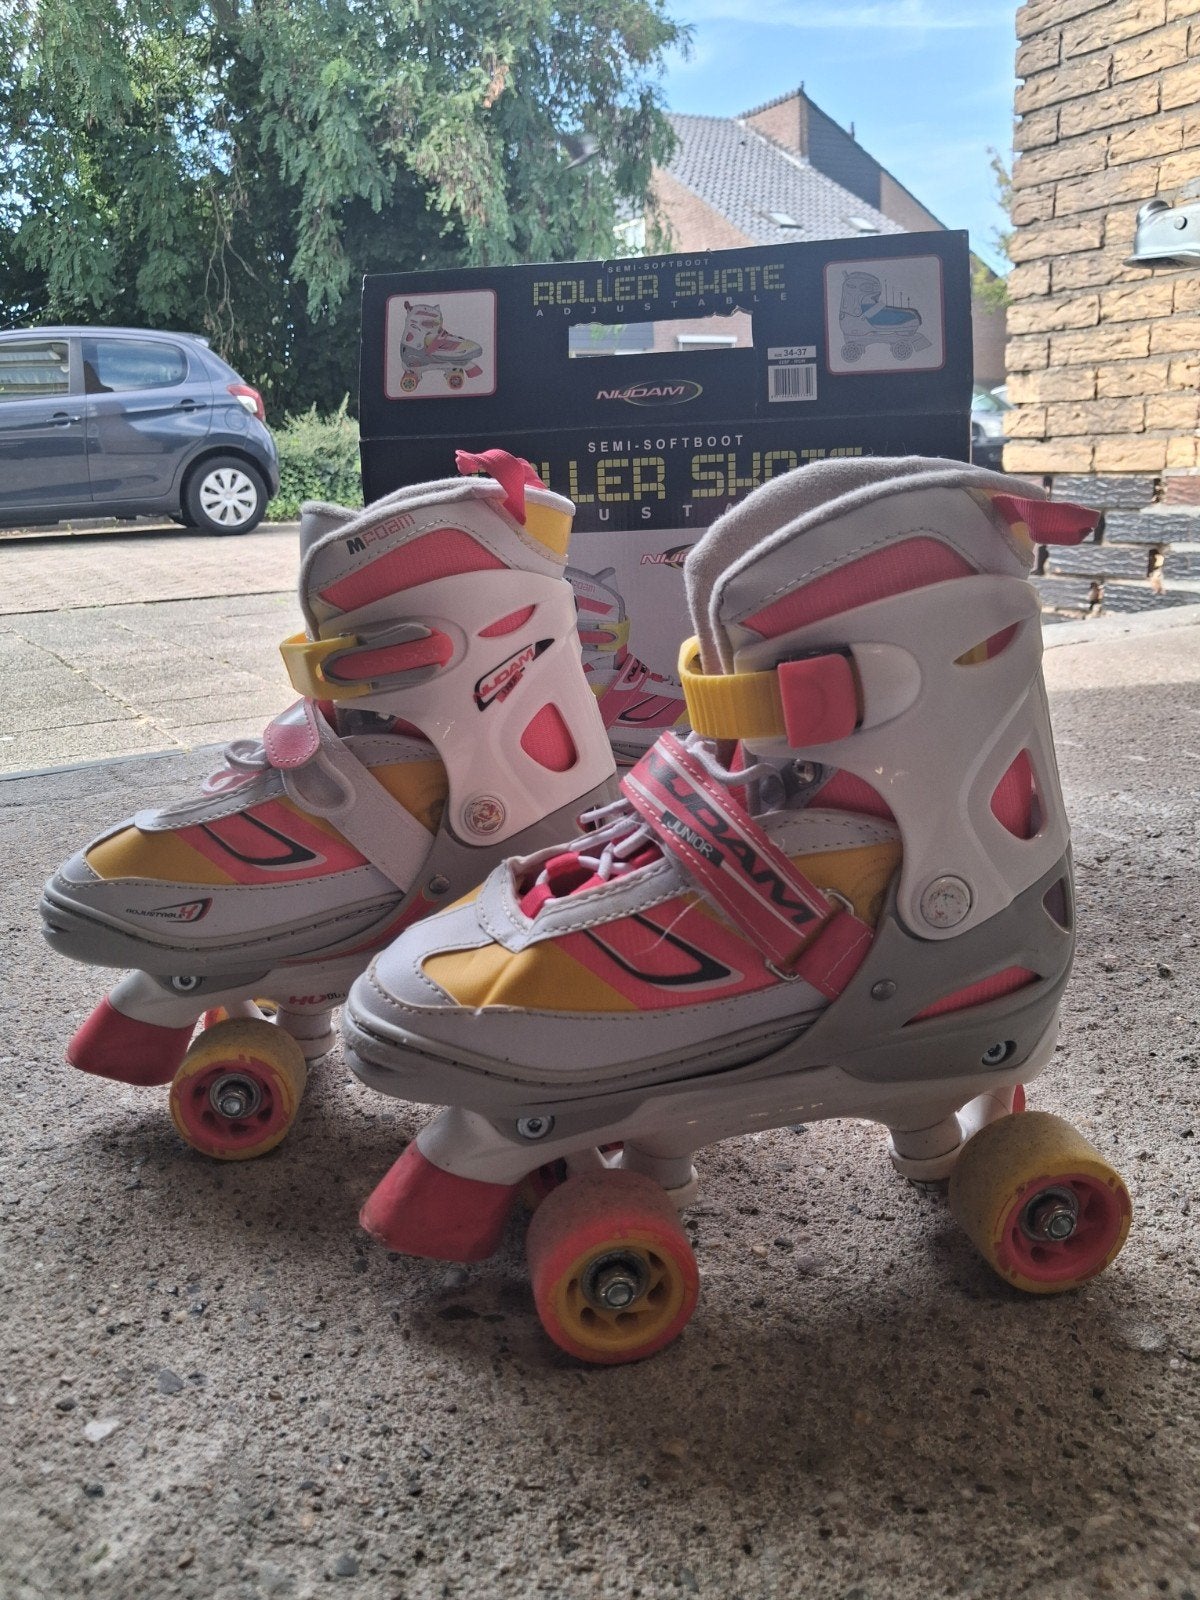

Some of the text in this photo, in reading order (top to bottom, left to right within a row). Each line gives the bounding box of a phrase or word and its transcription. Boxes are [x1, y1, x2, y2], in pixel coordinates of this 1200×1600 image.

[607, 258, 710, 273] SEMI-SOFTBOOT
[533, 264, 786, 306] ROLLER SKATE
[536, 292, 788, 317] ADJUSTABLE
[783, 348, 807, 357] 34-37
[596, 385, 685, 400] NIJDAM
[587, 434, 744, 453] SEMI-SOFTBOOT
[640, 551, 688, 566] NIJ
[665, 820, 714, 858] JUNIOR
